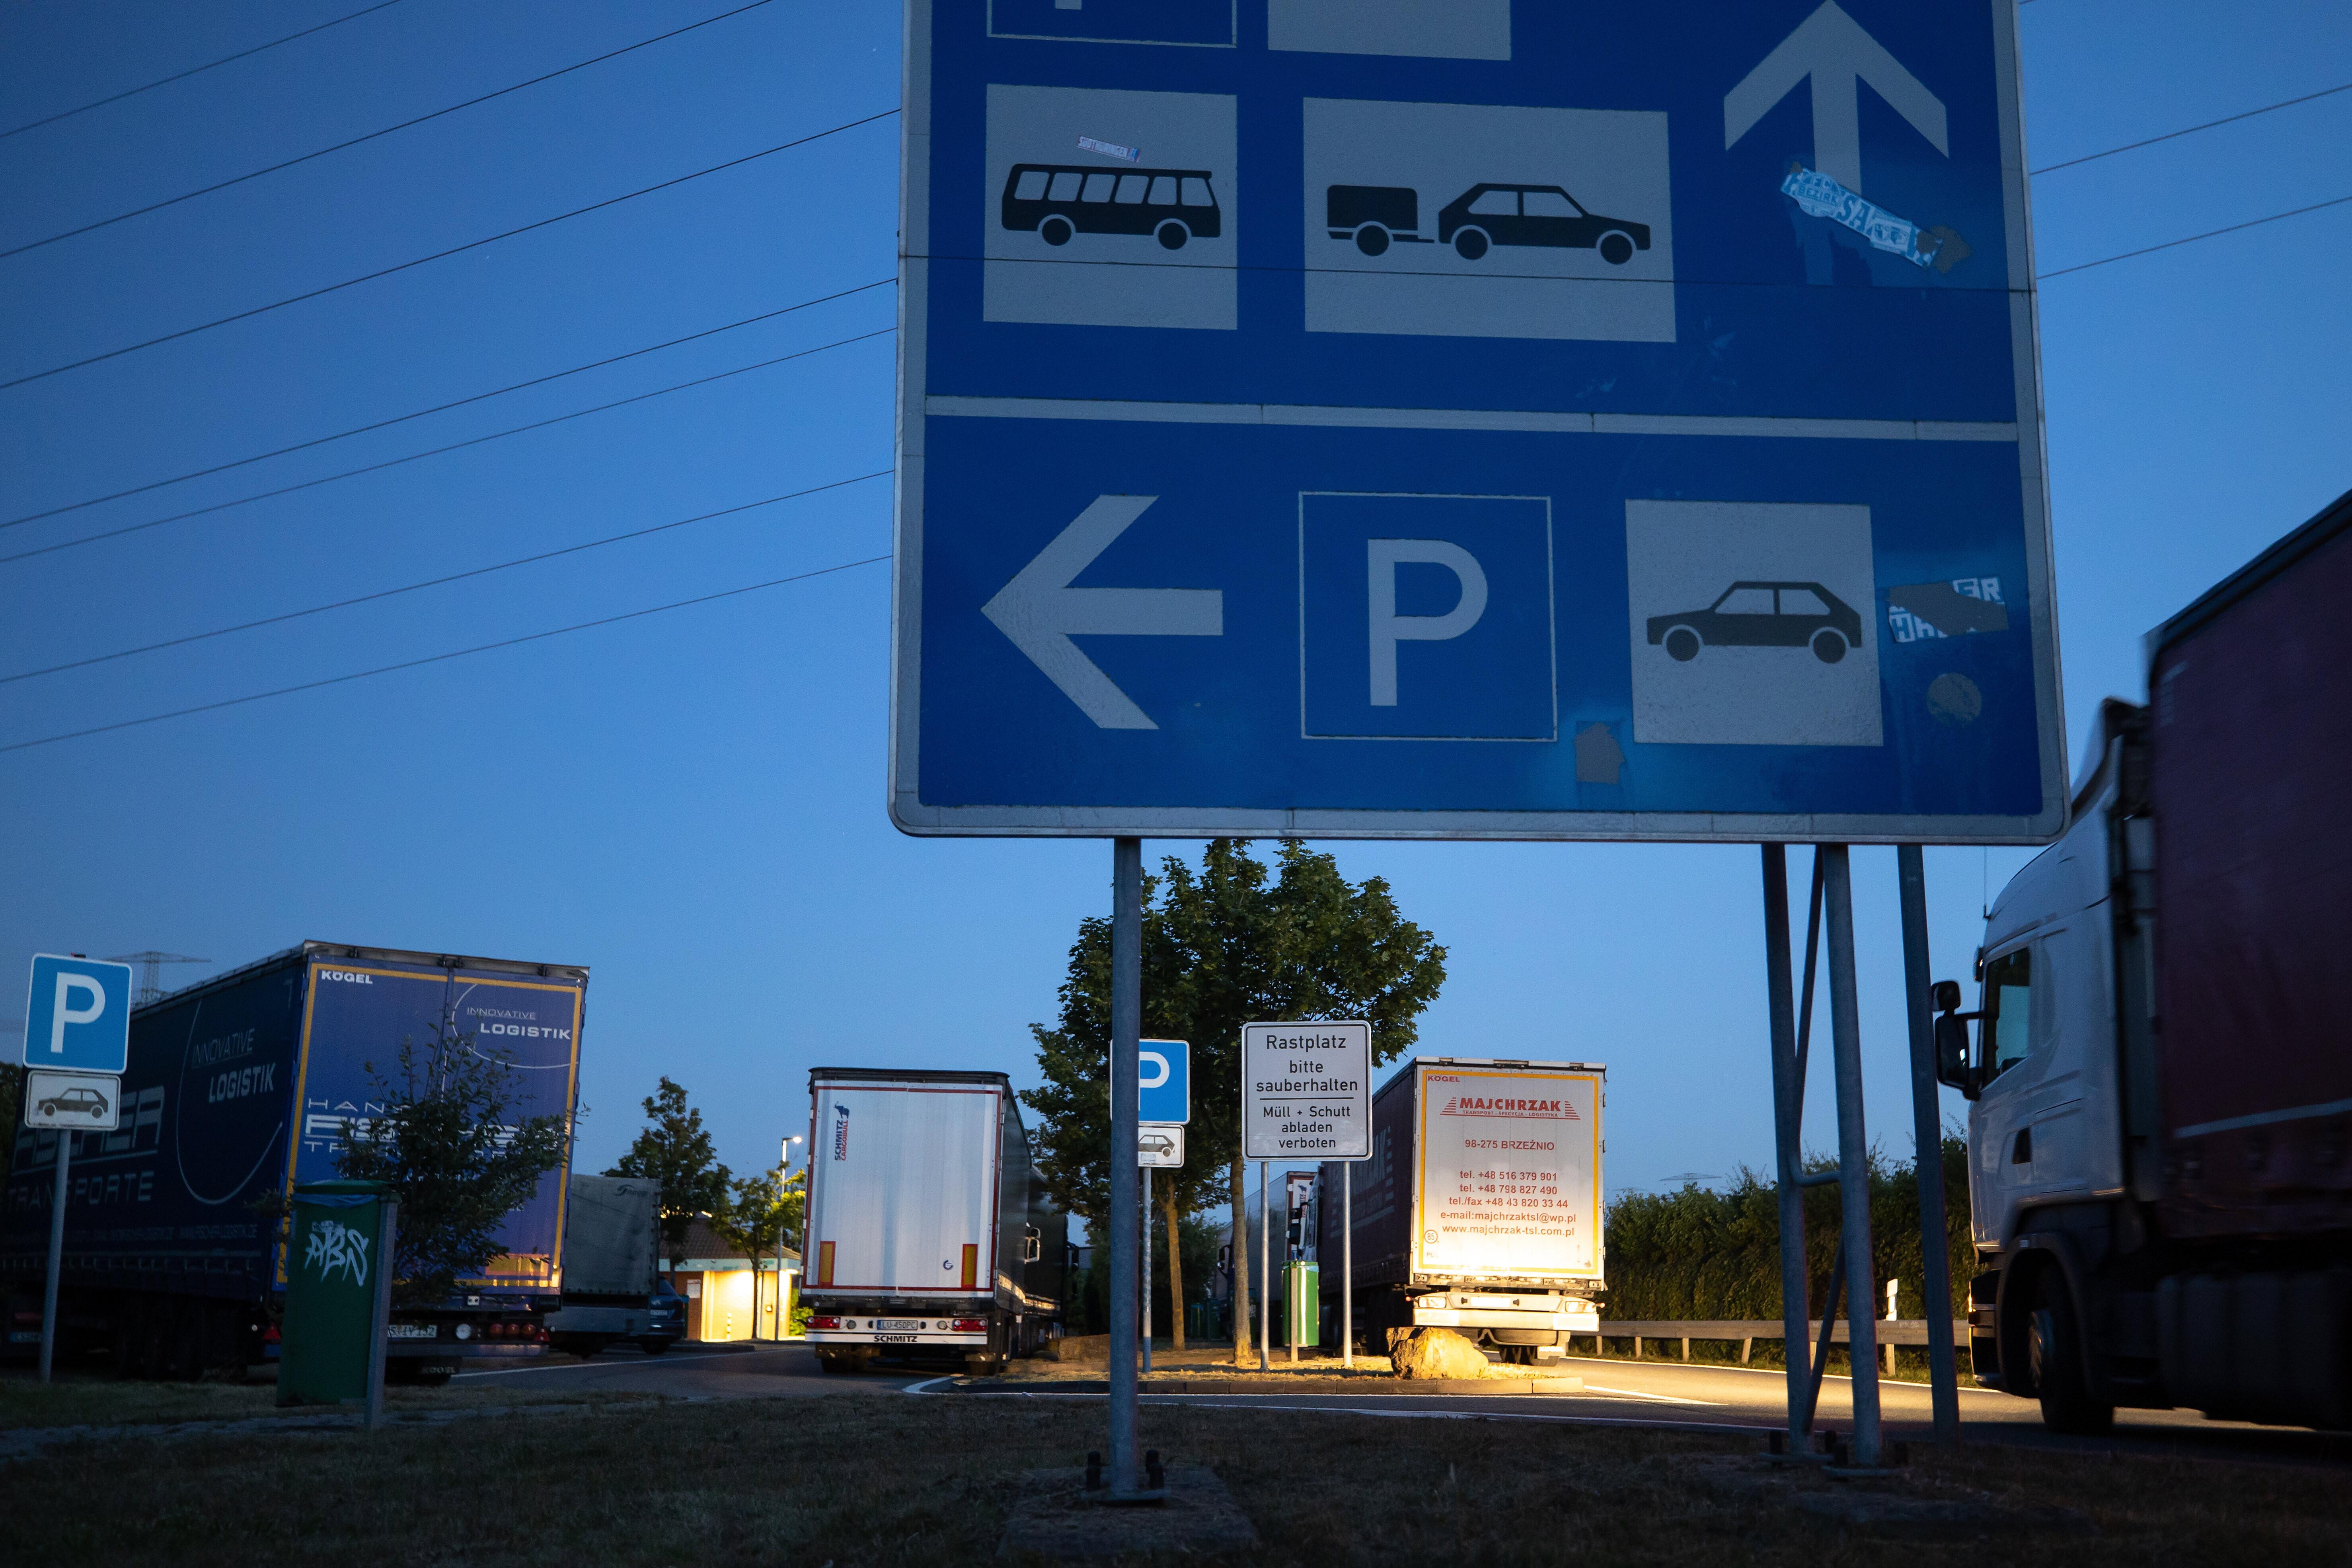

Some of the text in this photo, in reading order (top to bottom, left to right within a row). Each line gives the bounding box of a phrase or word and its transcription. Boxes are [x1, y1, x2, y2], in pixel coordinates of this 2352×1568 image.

[1368, 539, 1488, 706] P
[51, 972, 105, 1054] P
[467, 1007, 536, 1020] INNOVATIVE
[480, 1023, 571, 1040] LOGISTIK
[192, 1027, 255, 1065] INNOVATIVE
[1267, 1034, 1346, 1052] Rastplatz
[1290, 1060, 1323, 1073] bitte
[209, 1062, 276, 1103] LOGISTIK
[1139, 1052, 1170, 1111] P
[1256, 1078, 1358, 1092] sauberhalten
[1460, 1097, 1561, 1112] MAJCHRZAK
[1263, 1106, 1290, 1117] Müll
[1309, 1106, 1350, 1117] Schutt
[1282, 1122, 1332, 1133] abladen
[834, 1120, 843, 1161] SCHMITZ
[1279, 1137, 1336, 1148] verboten
[1465, 1139, 1554, 1150] 98-275 BRZEŹNIO
[1499, 1172, 1516, 1180] 516
[1520, 1172, 1537, 1180] 379
[1540, 1173, 1557, 1181] 901
[8, 1170, 155, 1213] TRANPORTE
[1460, 1184, 1557, 1195] tel. +48 798 827 490
[1449, 1197, 1482, 1206] tel./fax
[1485, 1198, 1503, 1206] +48
[1521, 1199, 1538, 1207] 820
[1542, 1199, 1553, 1208] 33
[1557, 1200, 1568, 1208] 44
[1441, 1211, 1576, 1224] e-mail:majchrzaktsl@wp.pl
[1442, 1225, 1574, 1237] www.majchrzak-tsl.com.pl
